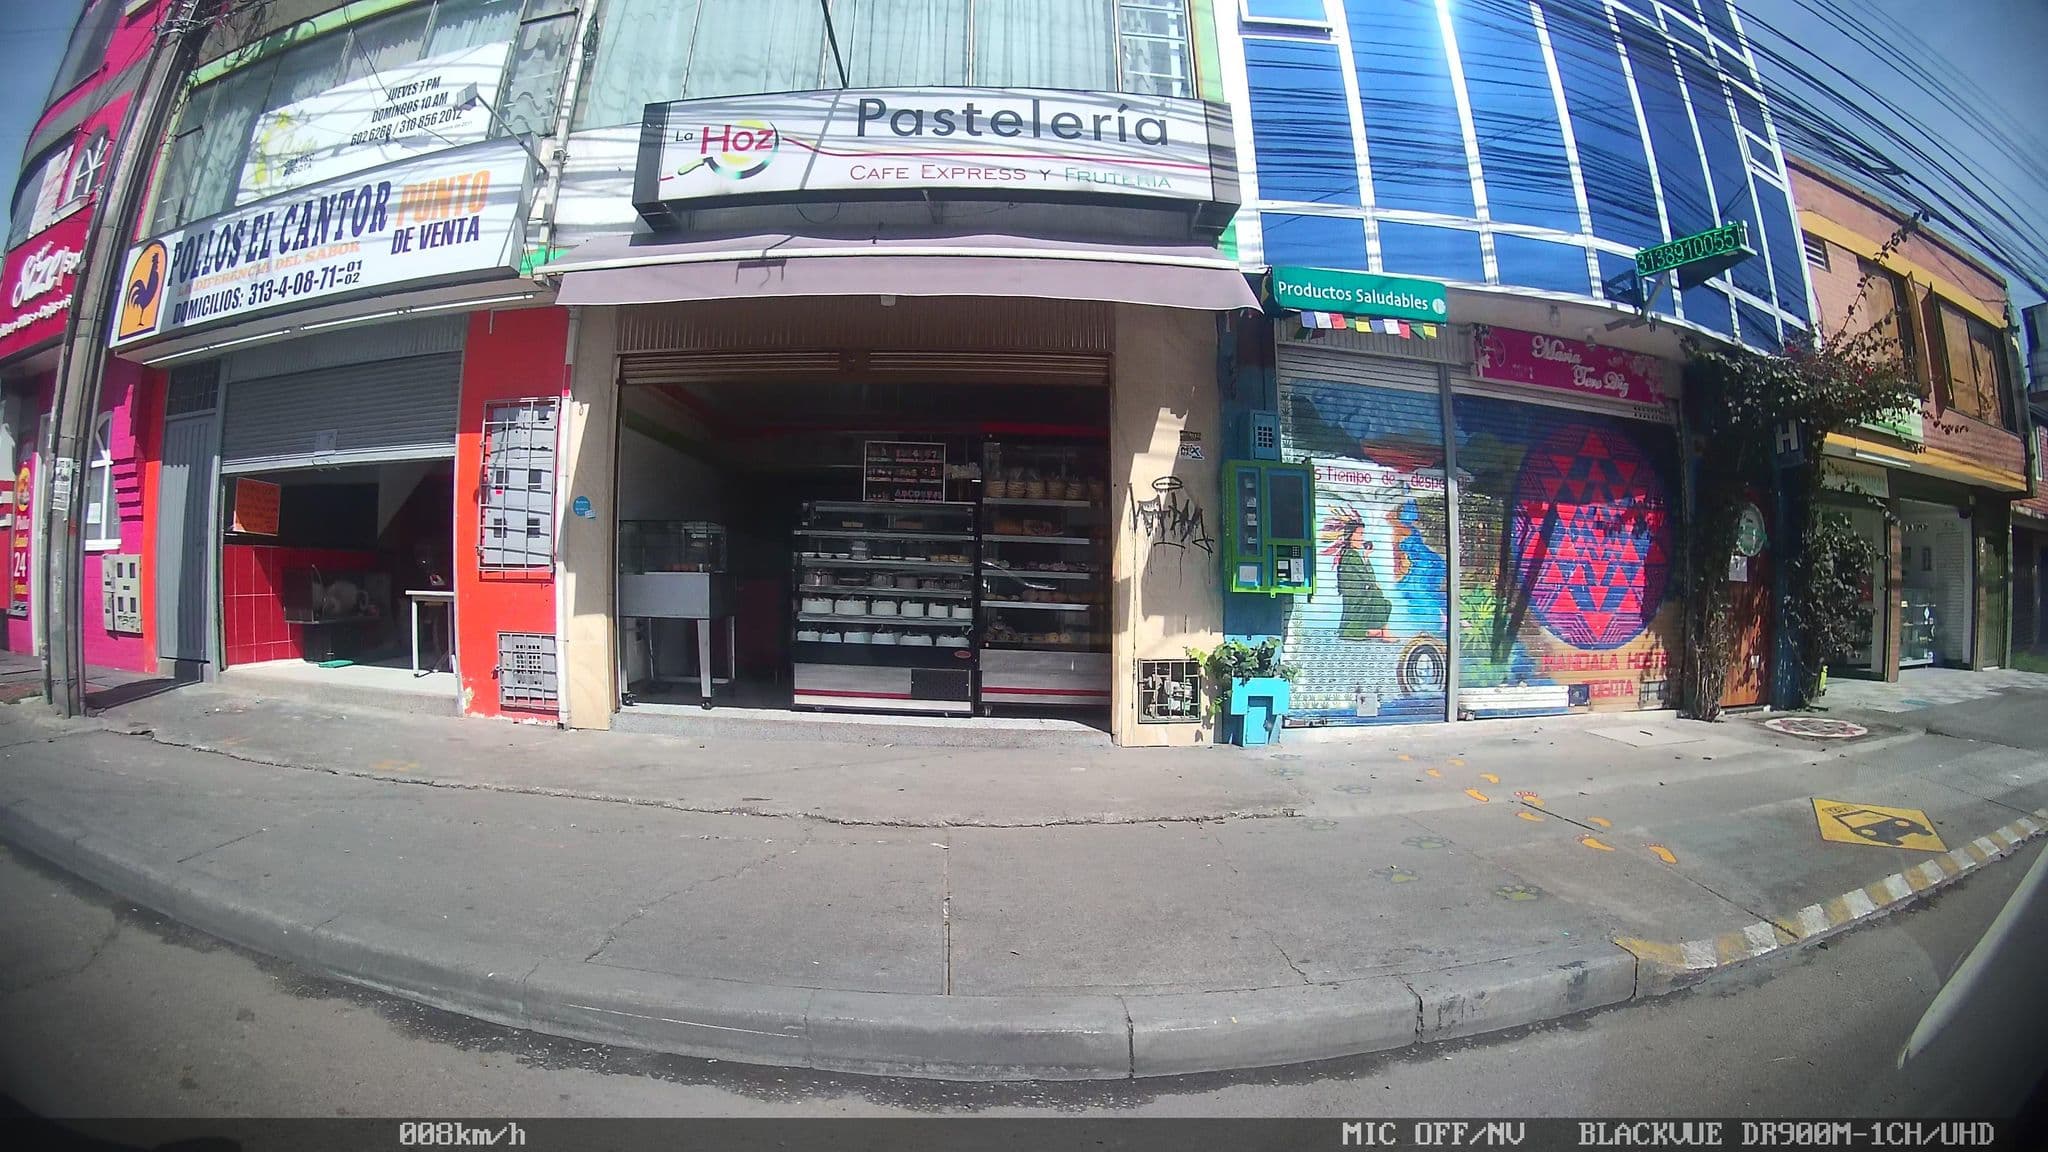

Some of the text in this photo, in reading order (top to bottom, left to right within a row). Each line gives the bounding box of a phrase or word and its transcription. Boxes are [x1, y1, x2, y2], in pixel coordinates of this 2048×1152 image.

[425, 76, 441, 92] PM
[372, 92, 449, 123] DOMINGOS 10 AM
[857, 97, 1168, 145] Pastelería
[676, 124, 774, 154] La Hoz
[850, 165, 909, 180] CAFE
[921, 165, 1026, 181] EXPRESS
[396, 170, 491, 227] PUNTO
[167, 180, 392, 287] POLLOS EL CANTOR
[391, 216, 480, 255] DE VENTA
[1637, 228, 1735, 273] 3138910055
[173, 290, 244, 324] DOMICILIOS:
[1278, 281, 1428, 310] Productos Saludables
[1381, 470, 1395, 485] de
[14, 552, 26, 577] 24
[1541, 653, 1618, 671] MANDALA
